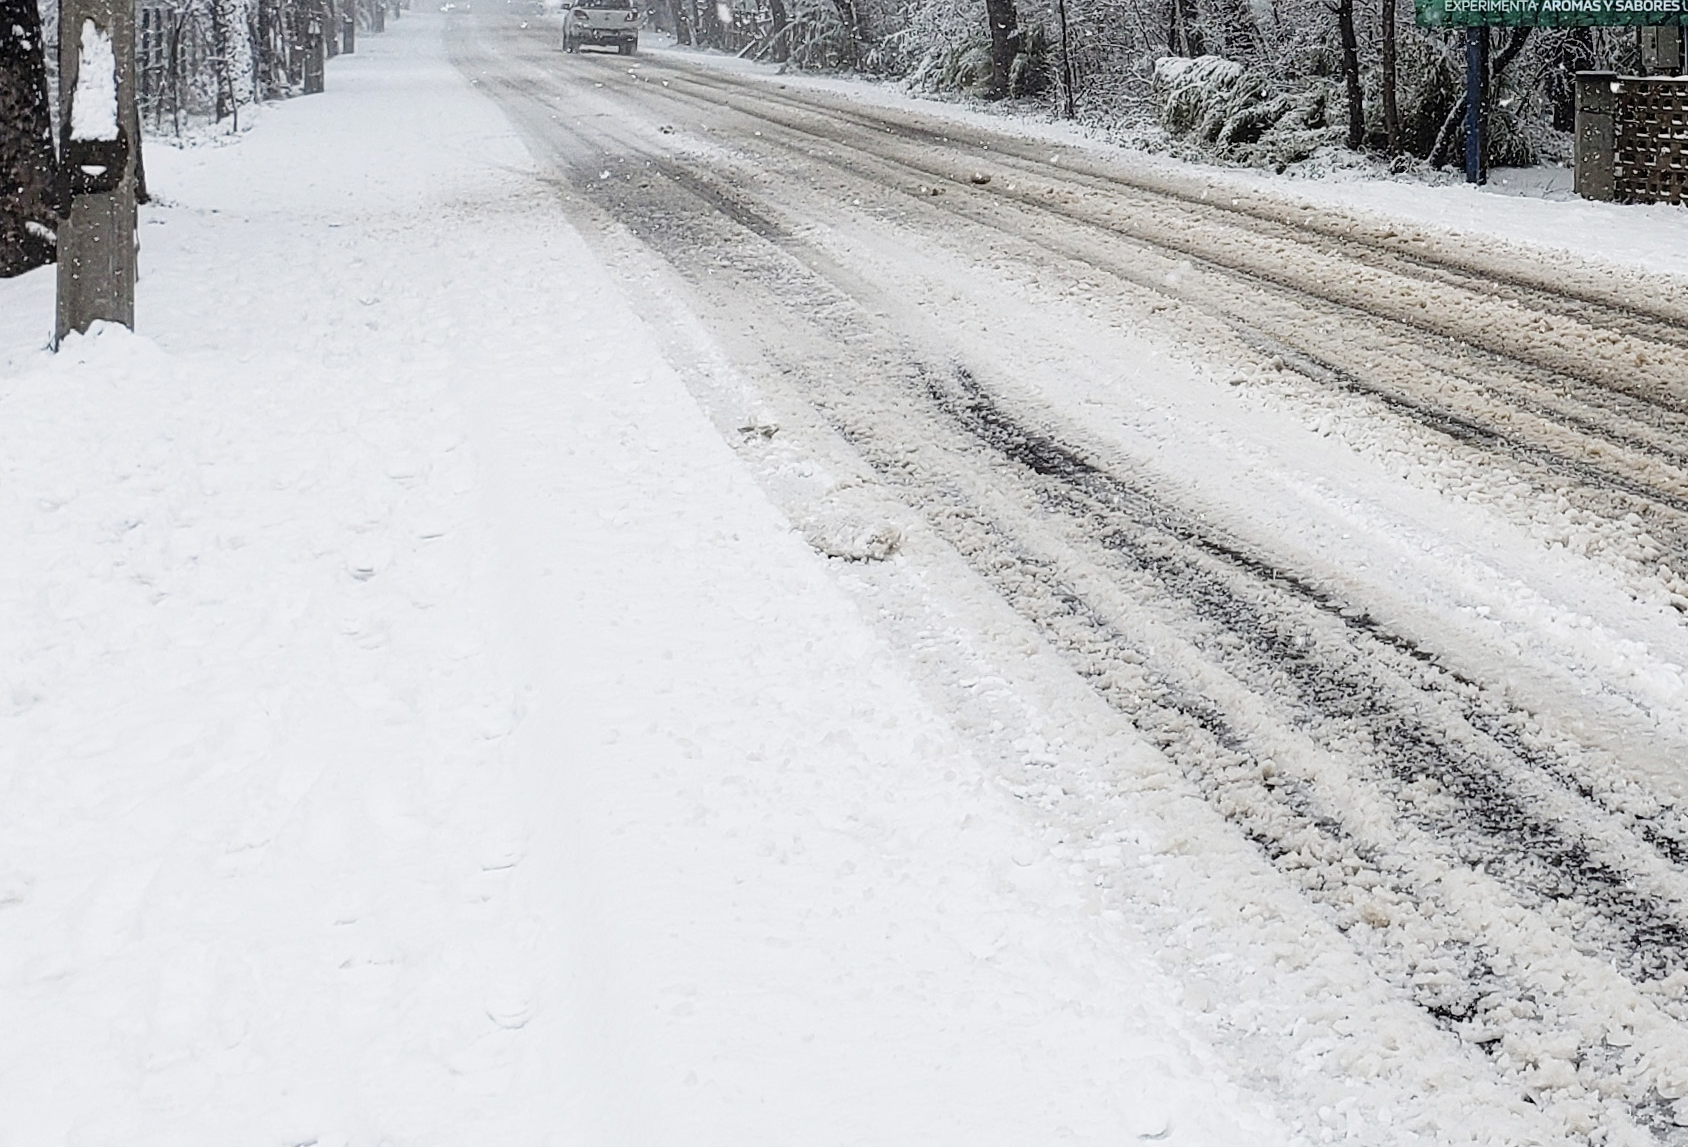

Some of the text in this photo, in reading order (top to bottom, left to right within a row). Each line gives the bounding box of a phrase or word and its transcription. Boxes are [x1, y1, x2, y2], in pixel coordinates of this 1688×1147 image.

[1444, 0, 1538, 12] EXPERIMENTA
[1542, 0, 1602, 12] AROMAS
[1603, 0, 1614, 12] Y
[1615, 0, 1680, 12] SABORES
